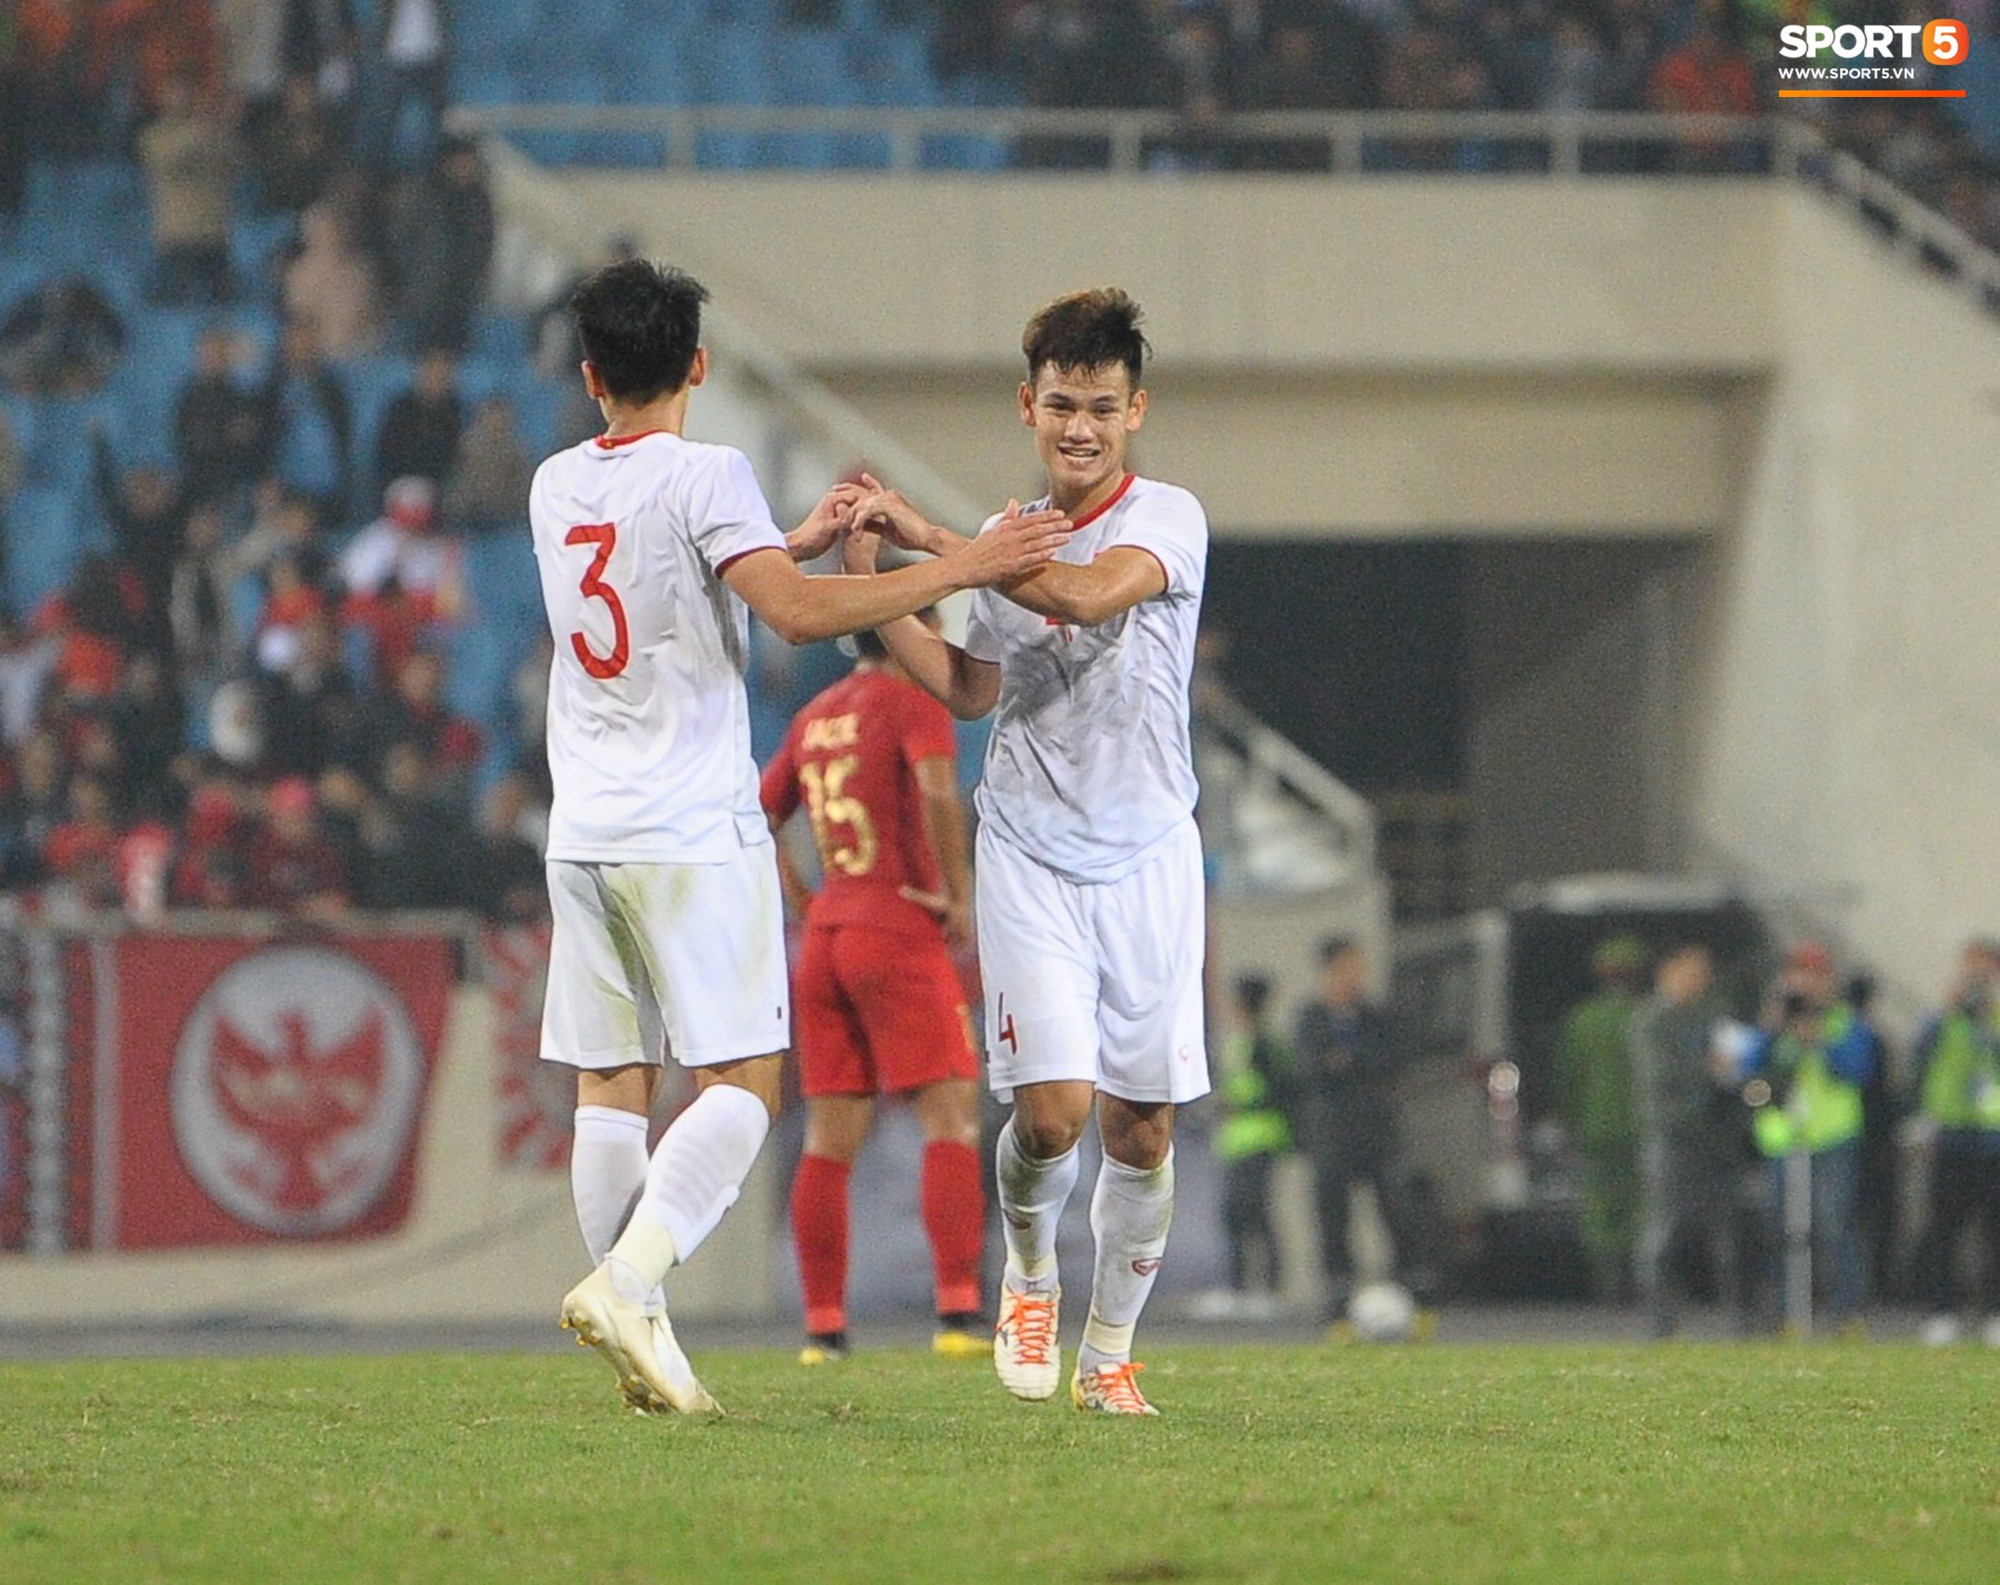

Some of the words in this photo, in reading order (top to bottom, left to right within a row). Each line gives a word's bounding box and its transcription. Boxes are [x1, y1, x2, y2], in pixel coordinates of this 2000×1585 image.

[564, 522, 629, 679] 3
[799, 754, 877, 877] 15
[998, 991, 1017, 1055] 4
